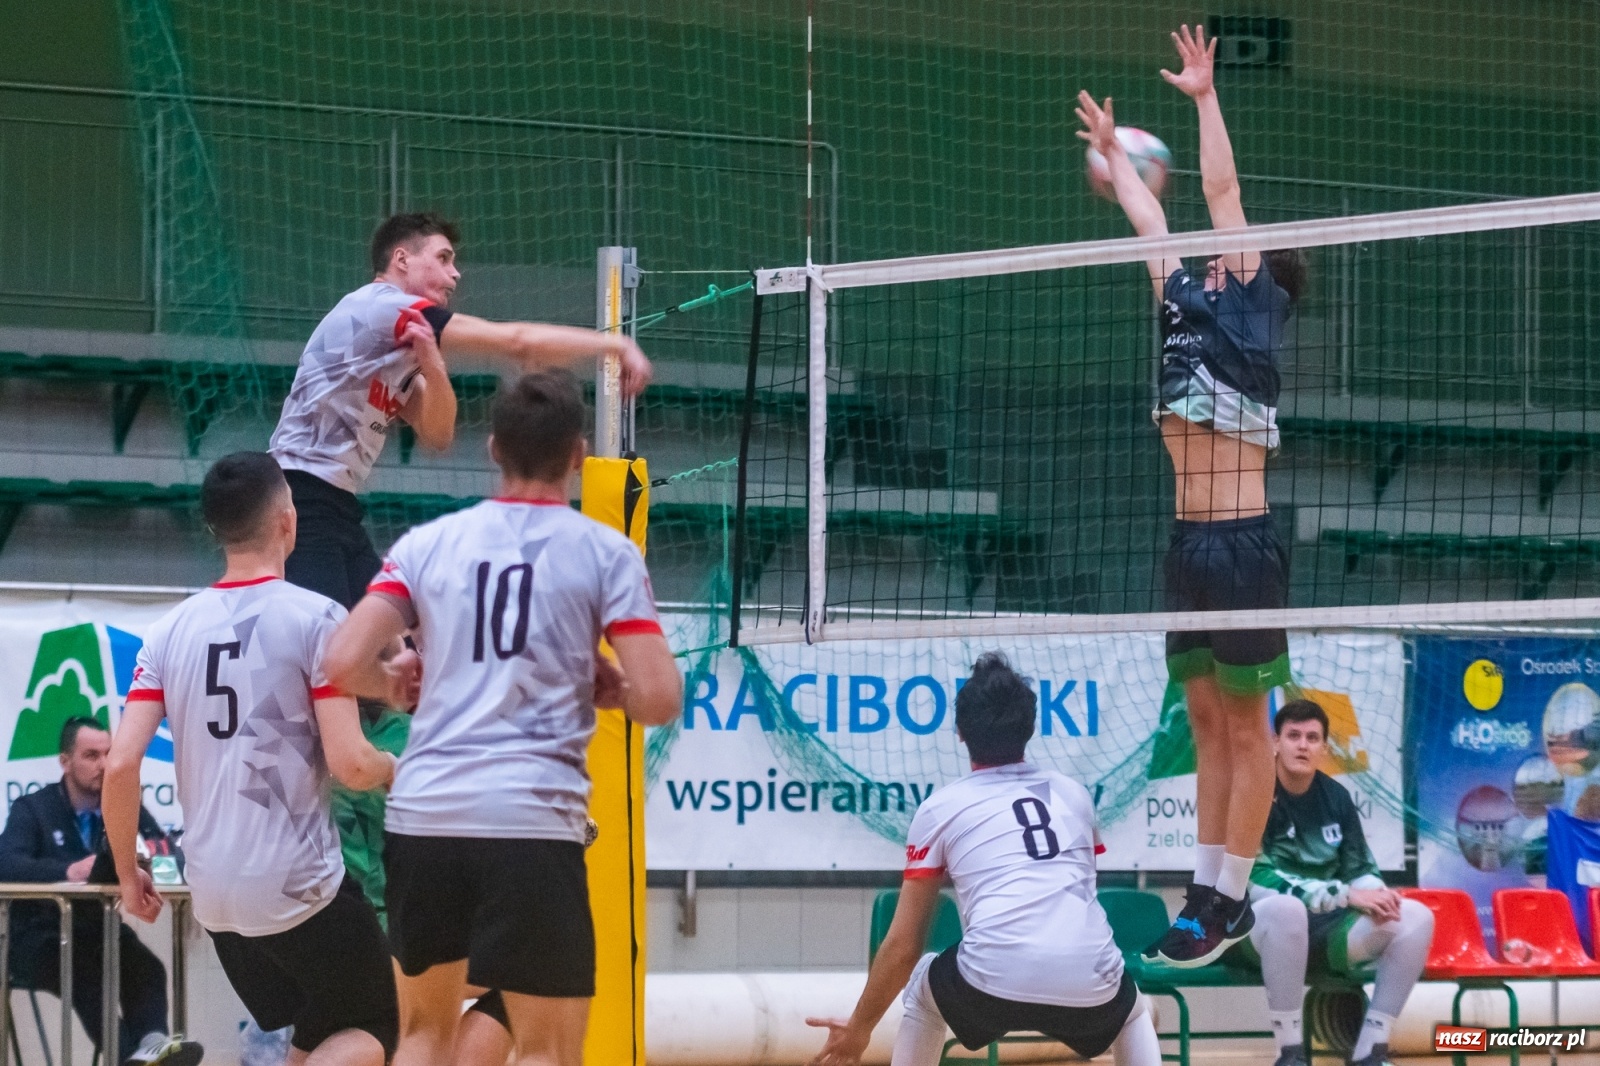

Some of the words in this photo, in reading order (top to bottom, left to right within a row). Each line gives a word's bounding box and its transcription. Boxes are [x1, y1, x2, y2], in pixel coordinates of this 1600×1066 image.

[473, 561, 533, 660] 10
[206, 641, 241, 739] 5
[683, 672, 1099, 737] RACIBOKI
[666, 767, 935, 826] wspieramy
[1012, 797, 1060, 861] 8
